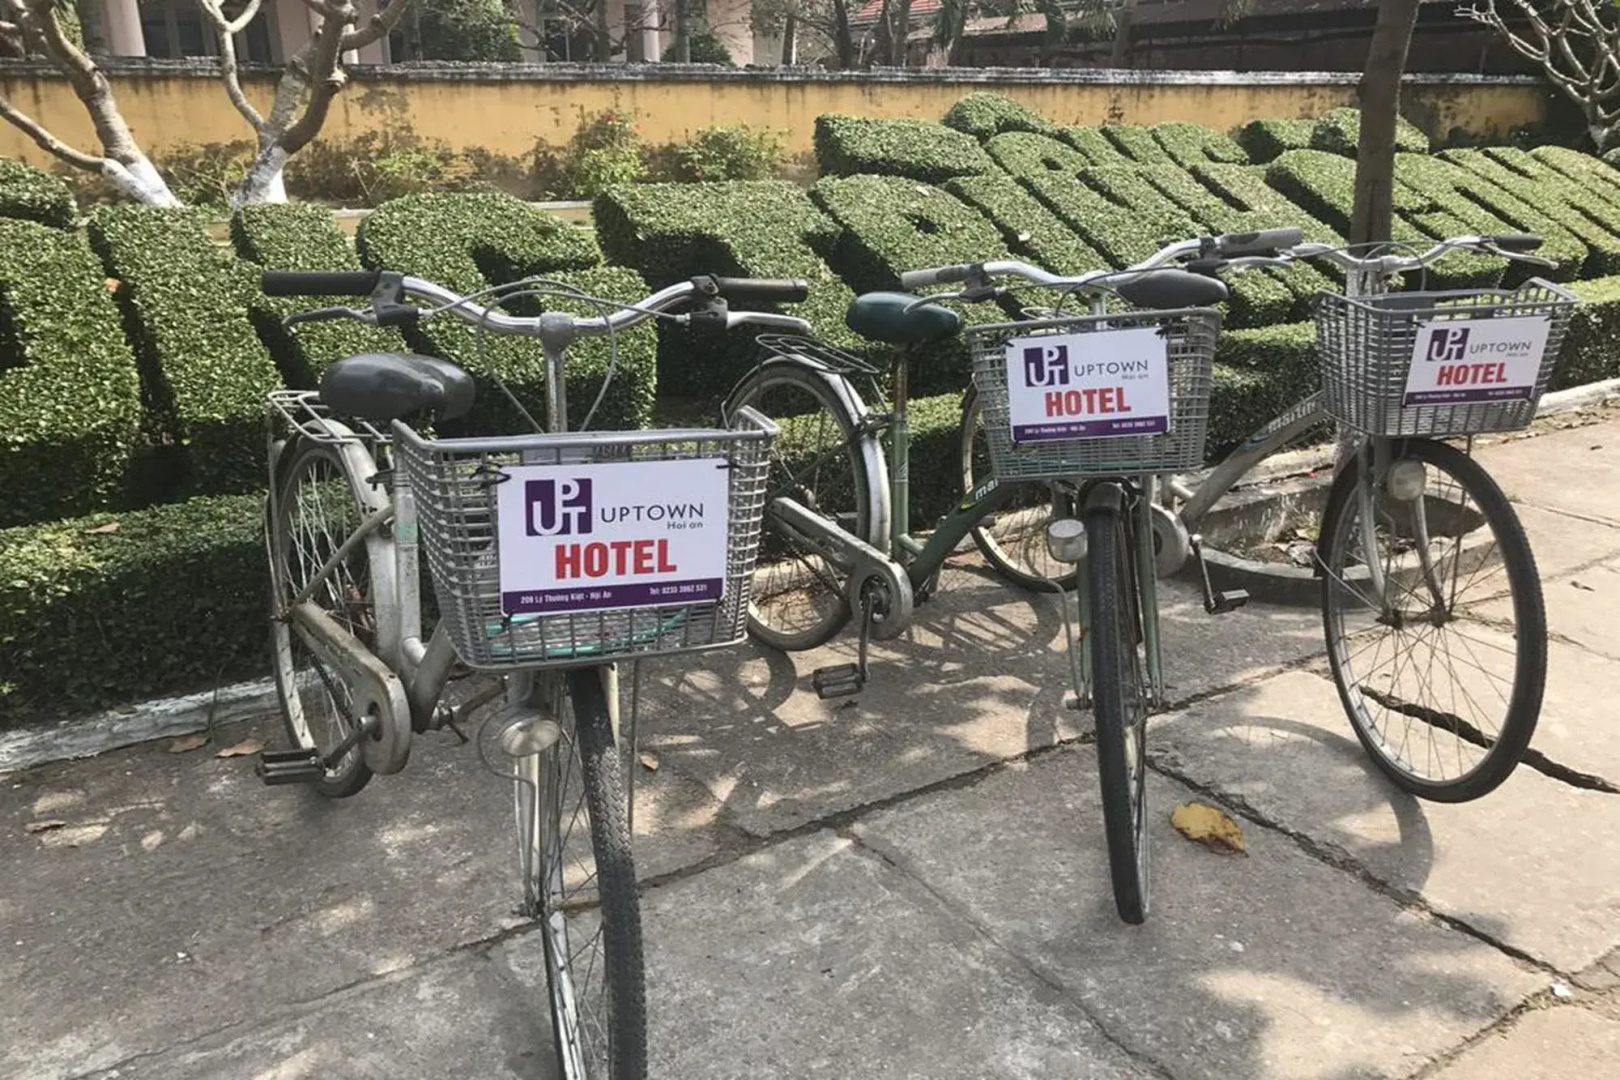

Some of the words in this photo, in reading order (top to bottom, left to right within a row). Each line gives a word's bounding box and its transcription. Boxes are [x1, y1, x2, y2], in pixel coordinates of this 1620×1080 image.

[1469, 341, 1532, 354] UPTOWN
[1074, 360, 1148, 377] UPTOWN
[1436, 362, 1507, 386] HOTEL
[1045, 387, 1131, 416] HOTEL
[601, 503, 703, 523] UPTOWN
[667, 521, 687, 530] Hoi
[689, 521, 703, 529] an
[555, 539, 677, 580] HOTEL
